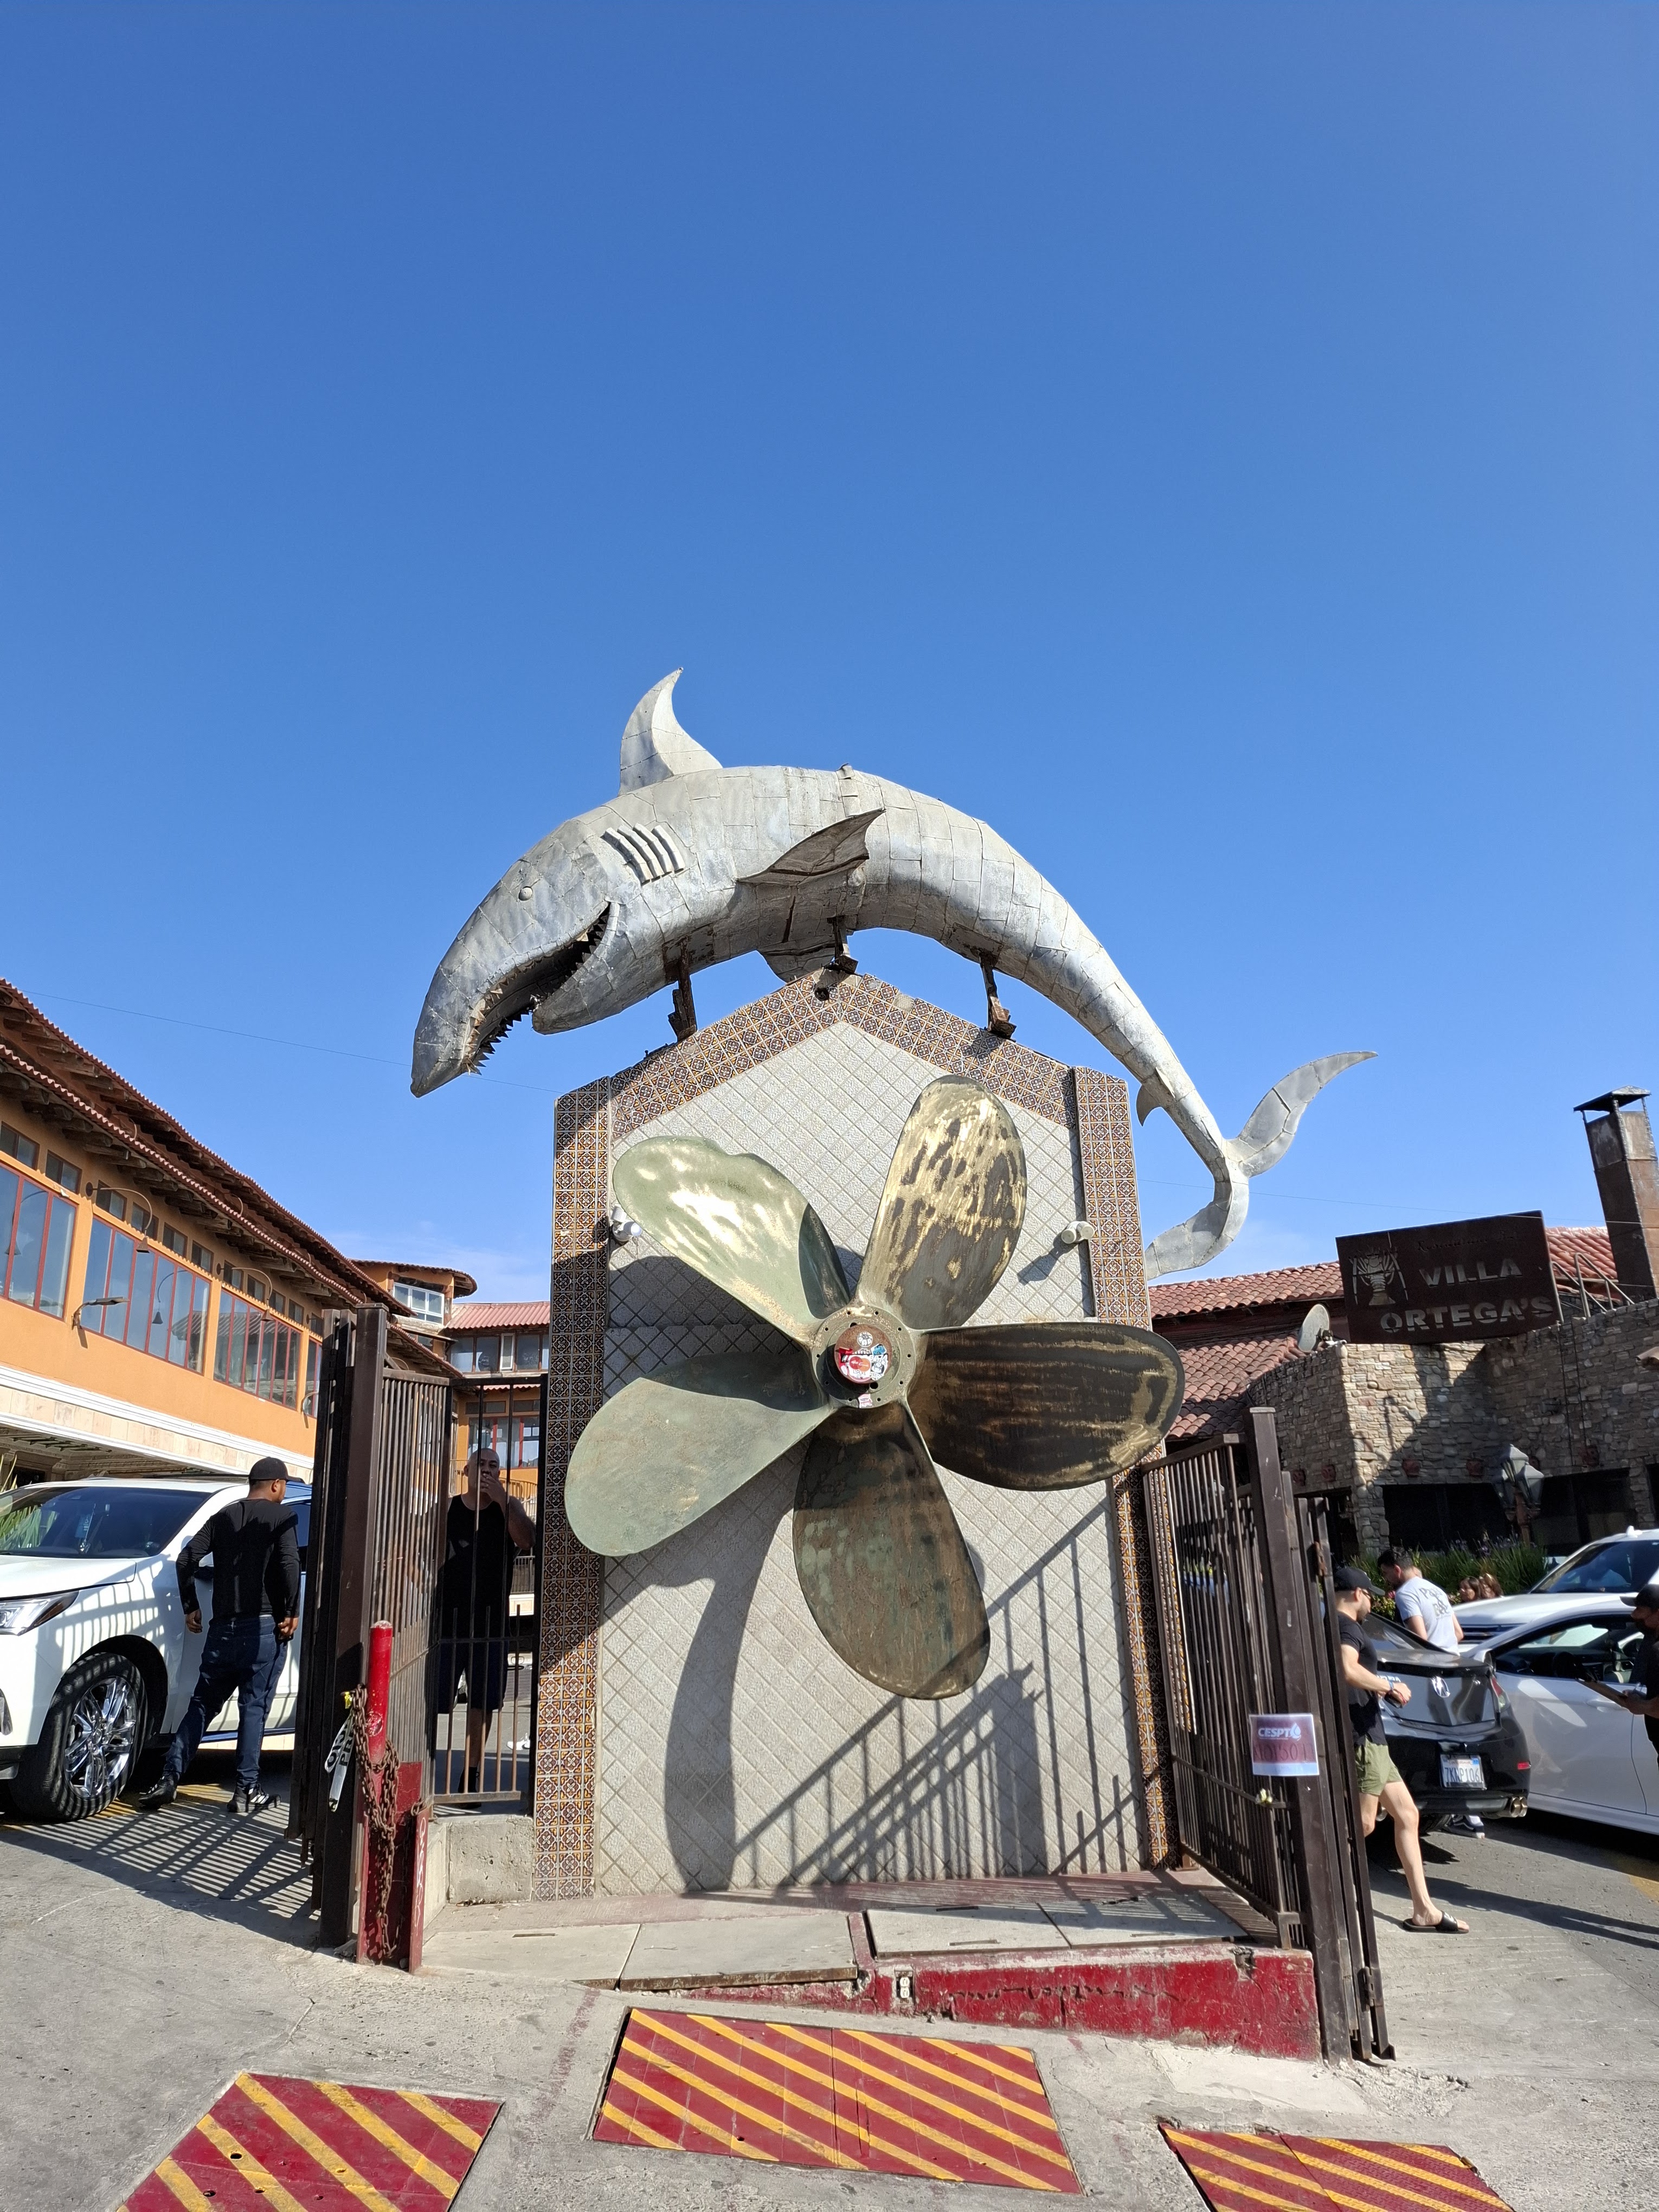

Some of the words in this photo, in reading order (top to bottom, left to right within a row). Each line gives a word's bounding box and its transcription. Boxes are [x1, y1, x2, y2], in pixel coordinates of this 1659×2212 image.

[1419, 1258, 1523, 1288] VILLA
[1380, 1296, 1554, 1333] ORTEGA'S
[1258, 1727, 1291, 1738] CESPT
